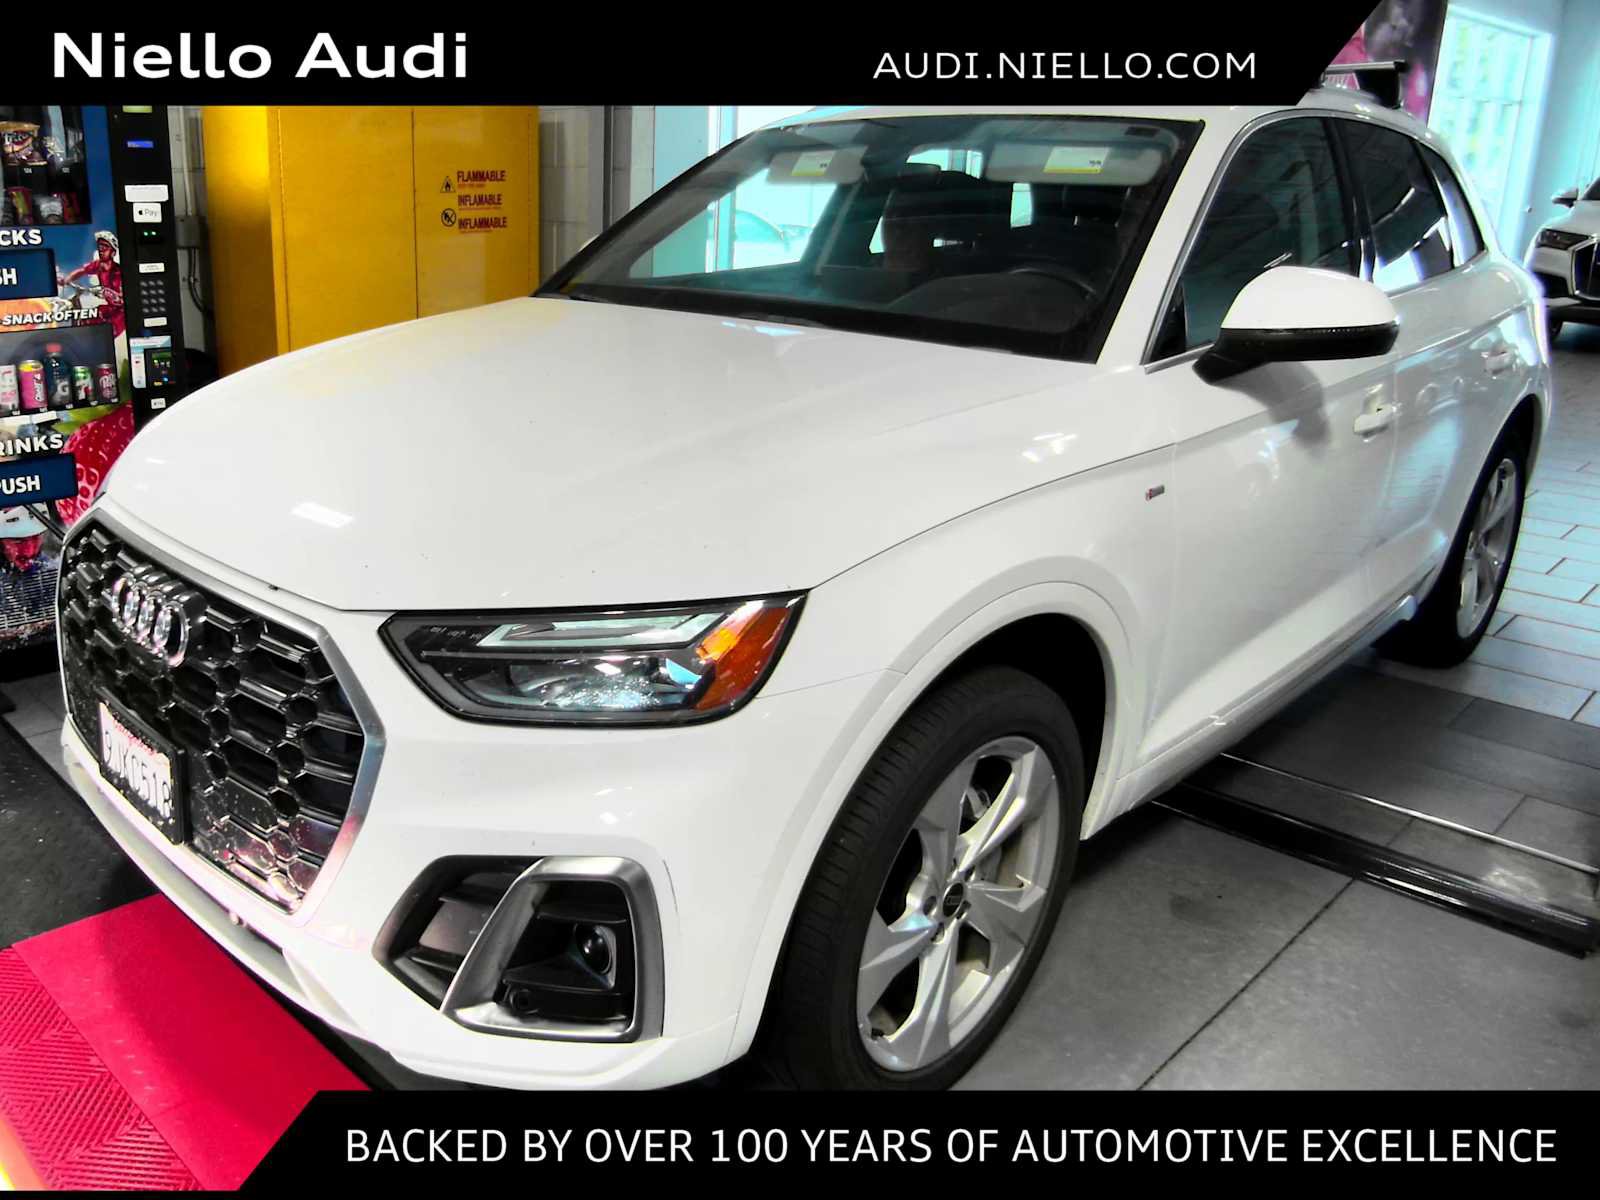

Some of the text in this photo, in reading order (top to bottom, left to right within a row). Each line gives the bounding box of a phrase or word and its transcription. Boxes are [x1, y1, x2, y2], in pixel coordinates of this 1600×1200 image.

[457, 170, 506, 182] FLAMMABLE
[458, 193, 502, 206] INFLAMABLE
[458, 216, 507, 230] INFLAMMABLE
